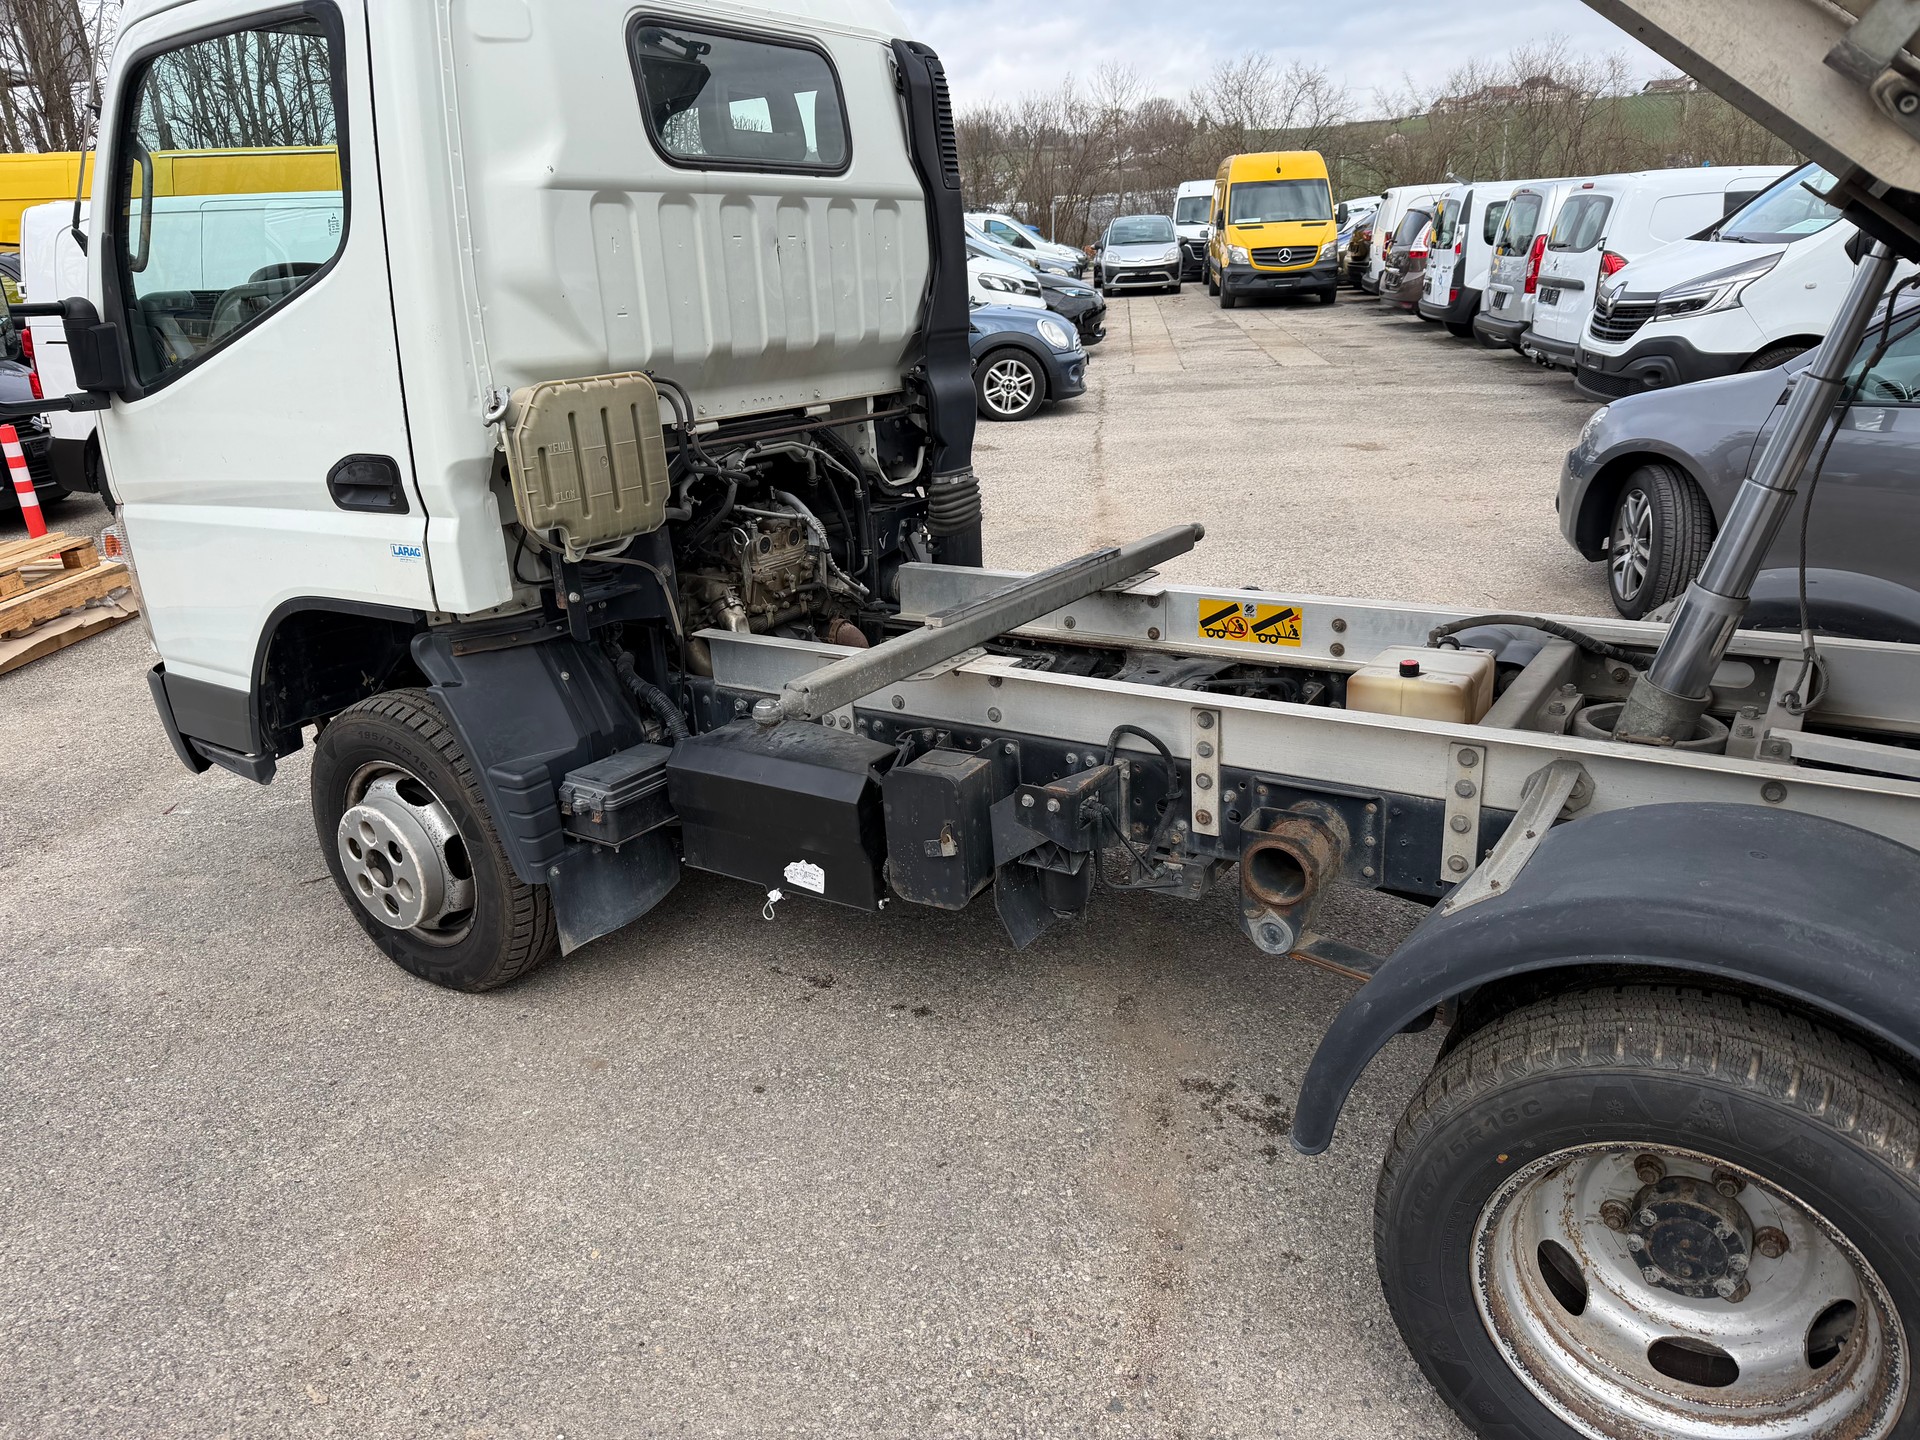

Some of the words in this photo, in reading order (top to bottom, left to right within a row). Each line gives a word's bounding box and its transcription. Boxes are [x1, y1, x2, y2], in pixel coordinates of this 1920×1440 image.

[552, 441, 573, 452] FULL
[392, 545, 421, 557] LARAG
[358, 730, 438, 780] 195/75R16C
